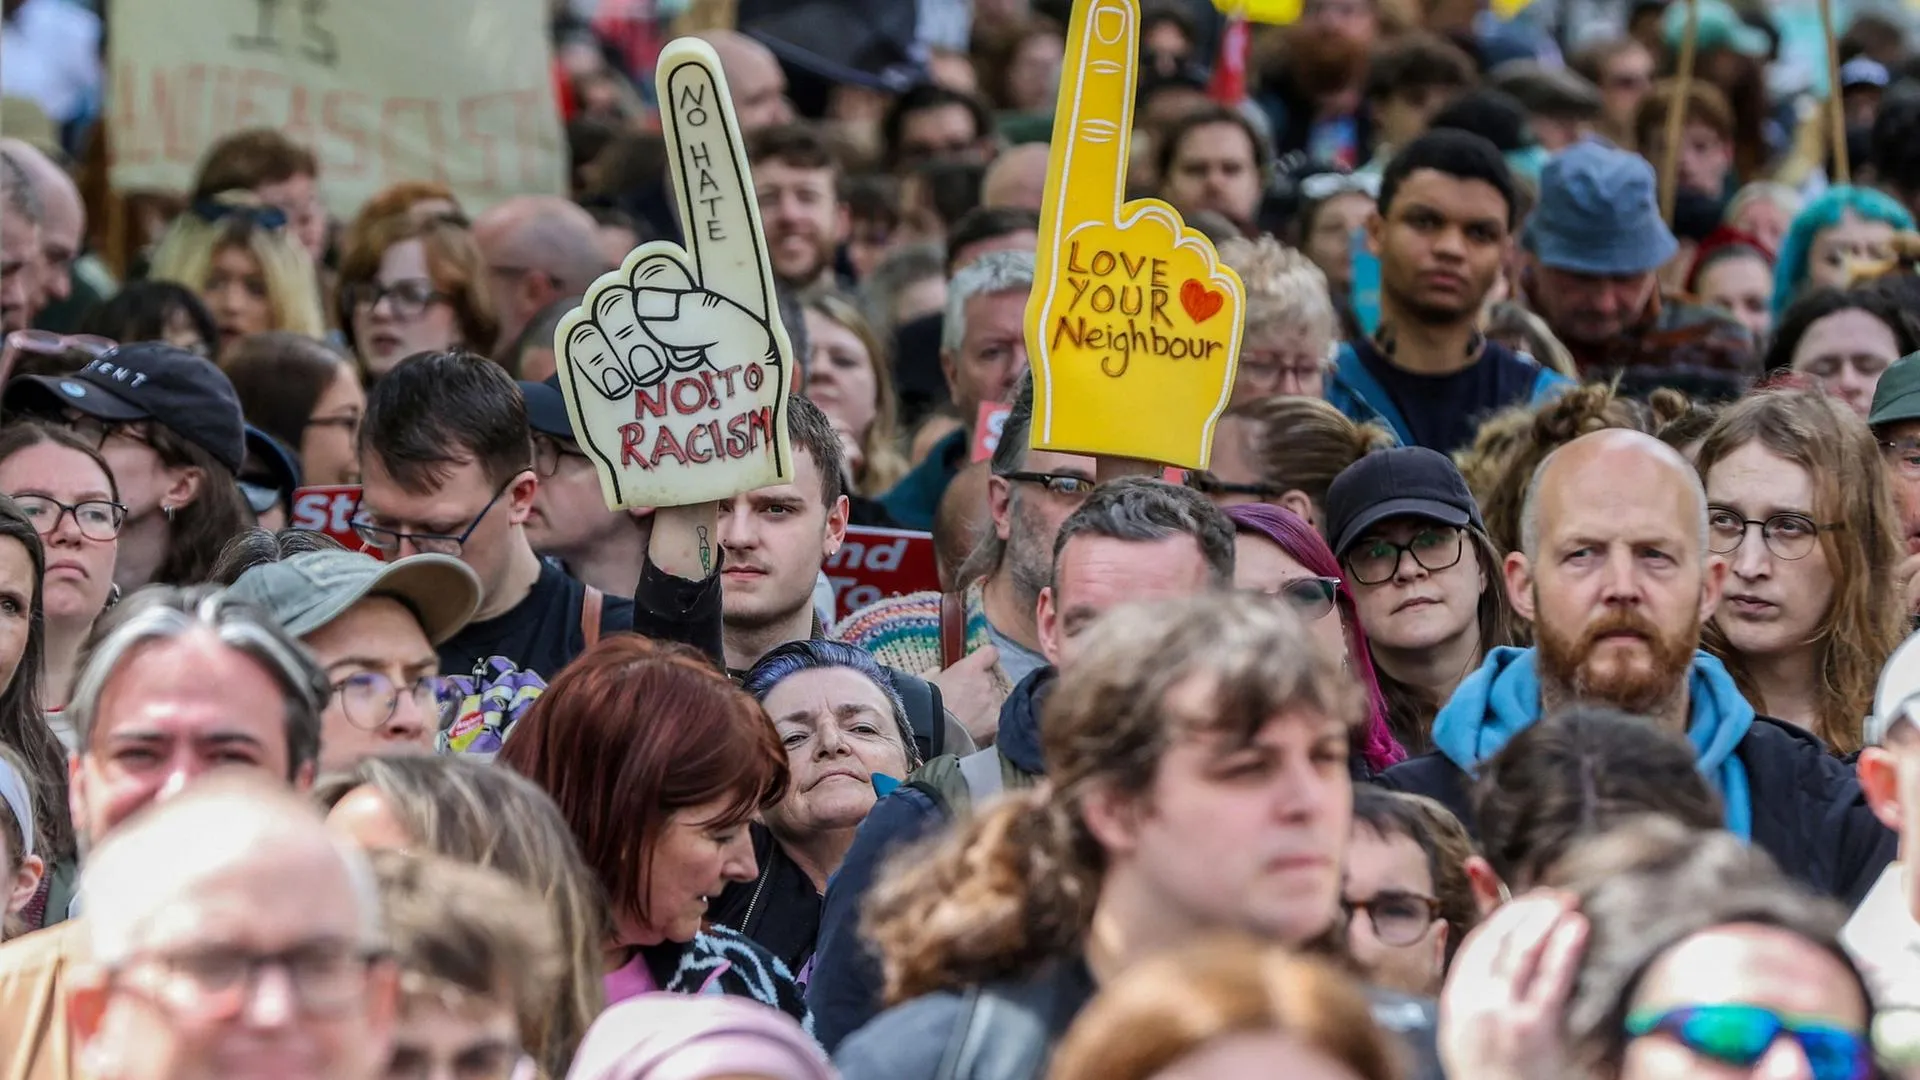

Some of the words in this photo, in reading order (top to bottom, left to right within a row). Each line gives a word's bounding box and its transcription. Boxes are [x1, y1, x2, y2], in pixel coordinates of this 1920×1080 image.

[680, 84, 707, 127] NO
[690, 141, 726, 241] HATE
[1067, 240, 1169, 288] LOVE
[1067, 277, 1174, 329] YOUR
[1052, 315, 1223, 378] Neighbour
[634, 371, 722, 420] NO!
[617, 405, 774, 471] RACISM
